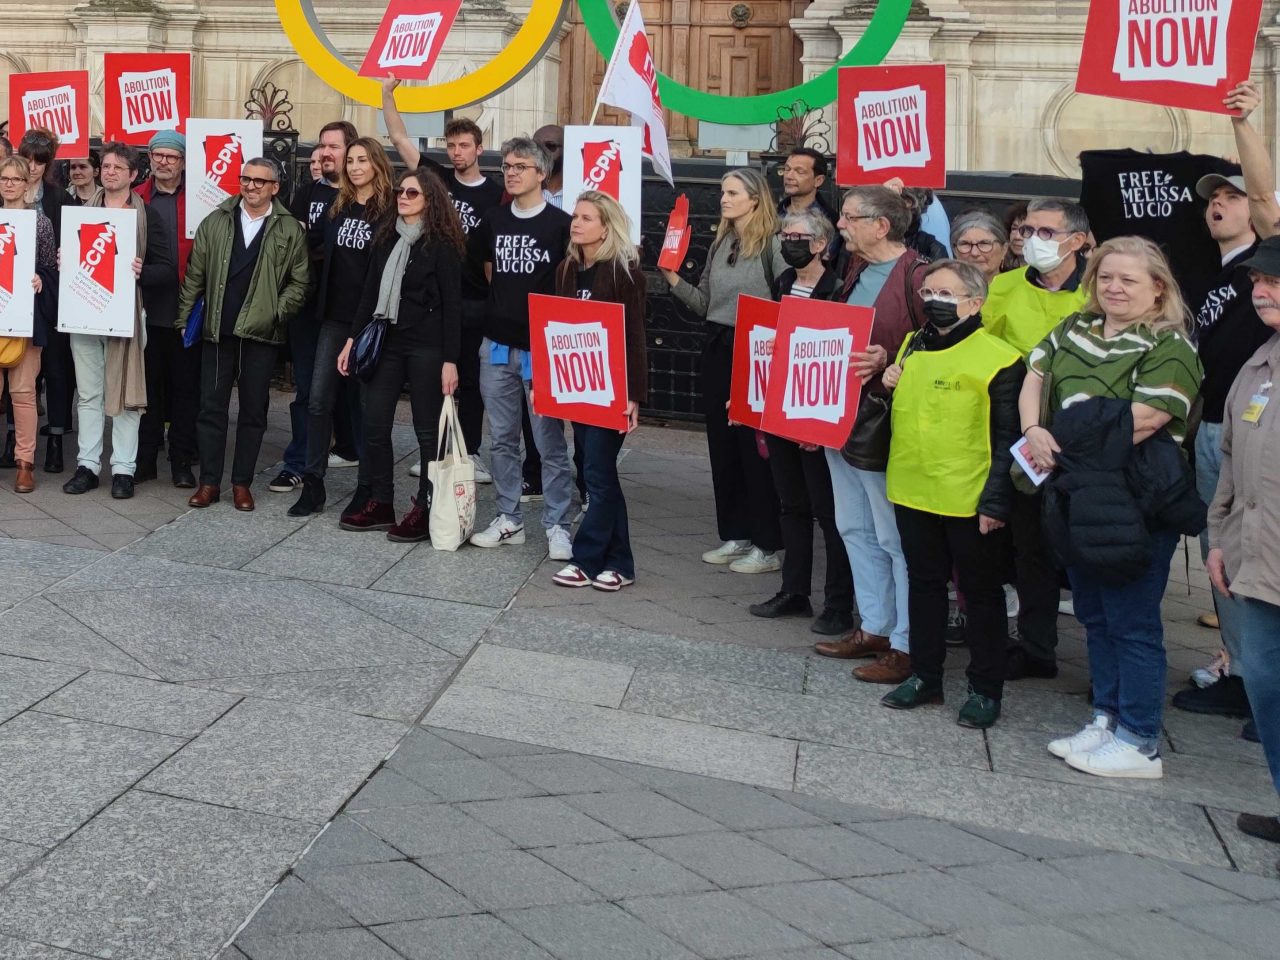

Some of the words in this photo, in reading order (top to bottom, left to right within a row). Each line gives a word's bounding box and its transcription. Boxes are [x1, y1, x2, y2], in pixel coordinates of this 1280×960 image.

[393, 18, 435, 34] ABOLITION
[385, 30, 432, 61] NOW
[1128, 16, 1218, 68] NOW
[124, 75, 170, 95] ABOLITION
[27, 92, 70, 111] ABOLITION
[126, 89, 173, 126] NOW
[861, 94, 918, 120] ABOLITION
[29, 105, 73, 136] NOW
[862, 113, 921, 160] NOW
[206, 135, 242, 186] ECPM
[583, 141, 620, 191] ECPM
[1118, 170, 1164, 188] FREE
[1121, 186, 1193, 203] MELISSA
[1124, 201, 1173, 218] LUCIO
[343, 218, 366, 230] REE
[80, 224, 116, 277] ECPM
[337, 237, 365, 250] UCIO
[496, 235, 530, 248] FREE
[495, 247, 550, 263] MELISSA
[496, 259, 535, 274] LUCIO
[1201, 283, 1238, 311] ISSA
[551, 331, 601, 351] ABOLITION
[794, 339, 844, 359] ABOLITION
[553, 351, 606, 393] NOW
[791, 360, 843, 407] NOW
